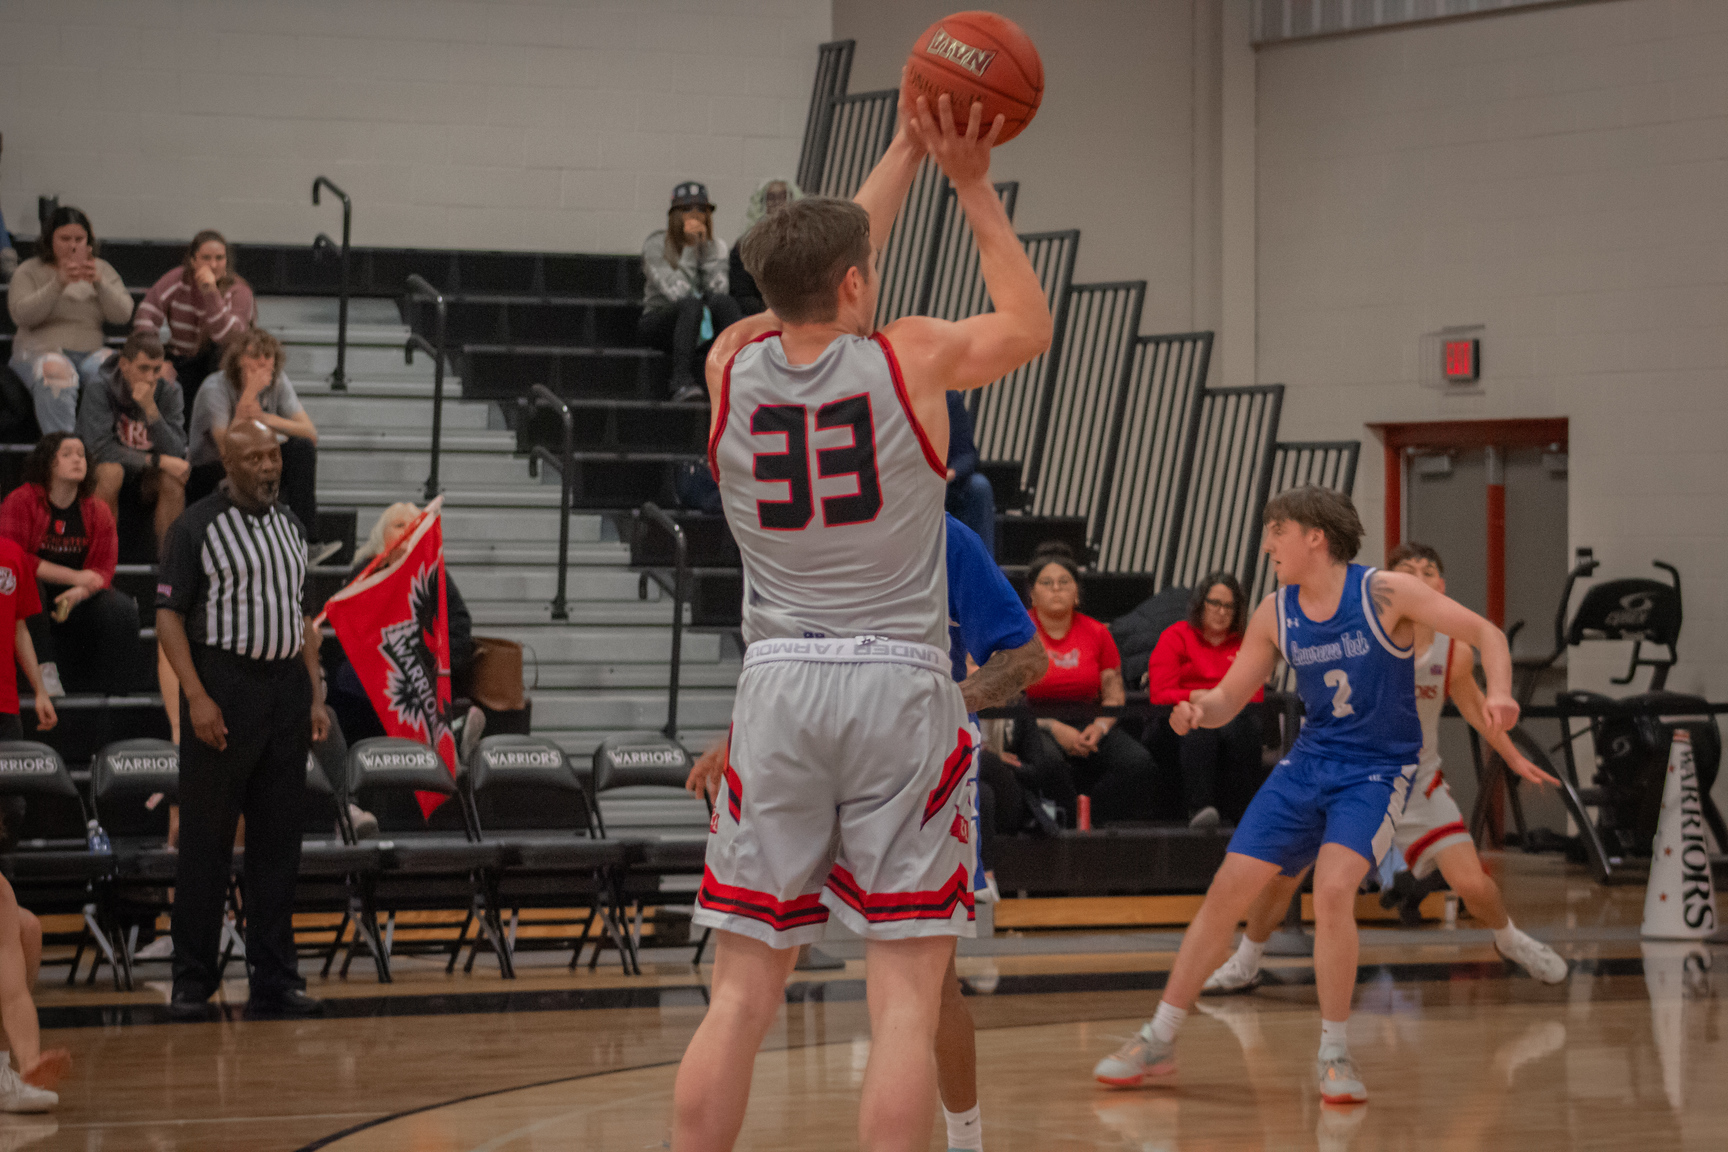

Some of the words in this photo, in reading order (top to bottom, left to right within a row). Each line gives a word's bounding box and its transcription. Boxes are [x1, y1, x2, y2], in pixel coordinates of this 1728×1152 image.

[1446, 341, 1470, 375] EXIT
[750, 391, 884, 531] 33
[853, 643, 939, 664] UNDER
[1323, 669, 1355, 718] 2
[0, 757, 54, 772] RRIORS
[111, 757, 178, 771] WARRIOR
[362, 753, 435, 768] WARRIORS
[487, 751, 560, 766] WARRIORS
[612, 749, 683, 765] WARRIORS
[1680, 750, 1714, 930] WARRIORS
